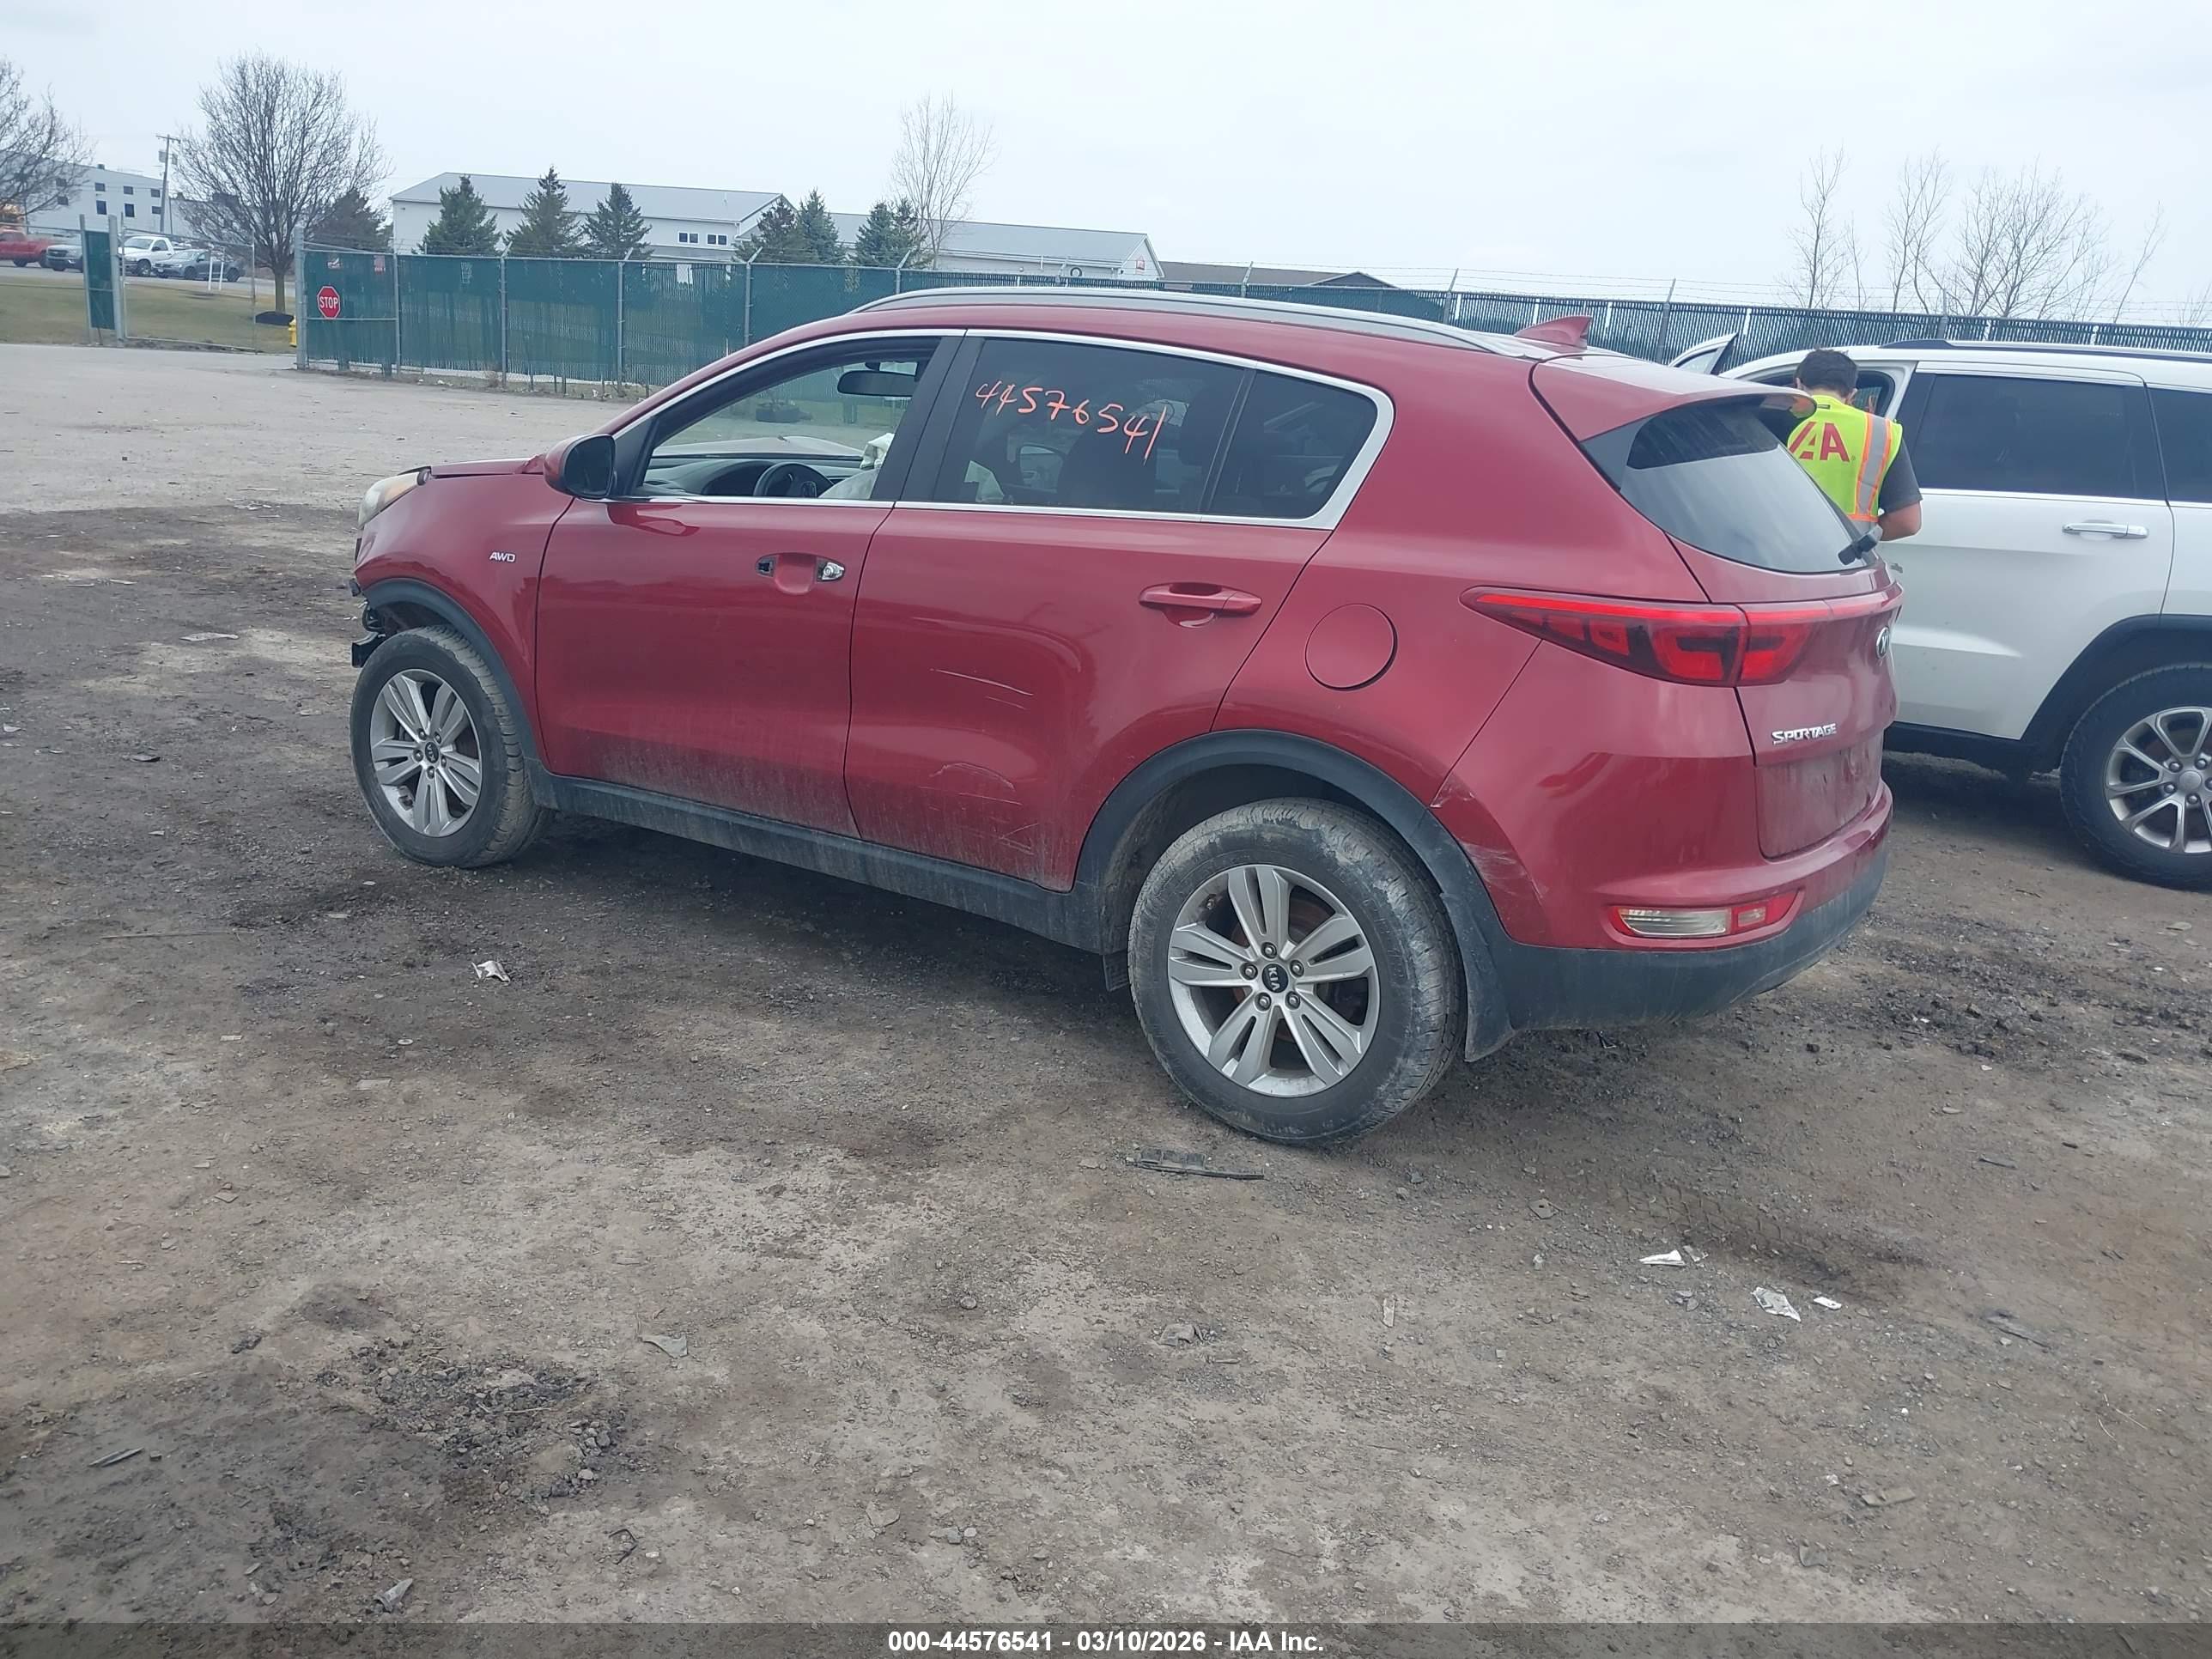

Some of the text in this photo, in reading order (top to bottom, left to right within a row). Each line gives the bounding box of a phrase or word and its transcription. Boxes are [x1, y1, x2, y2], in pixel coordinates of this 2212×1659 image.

[319, 296, 338, 309] STOP
[975, 380, 1167, 465] 44576541
[489, 551, 516, 562] AWD
[1771, 723, 1837, 745] SPORTAGE
[1268, 967, 1280, 991] KIA
